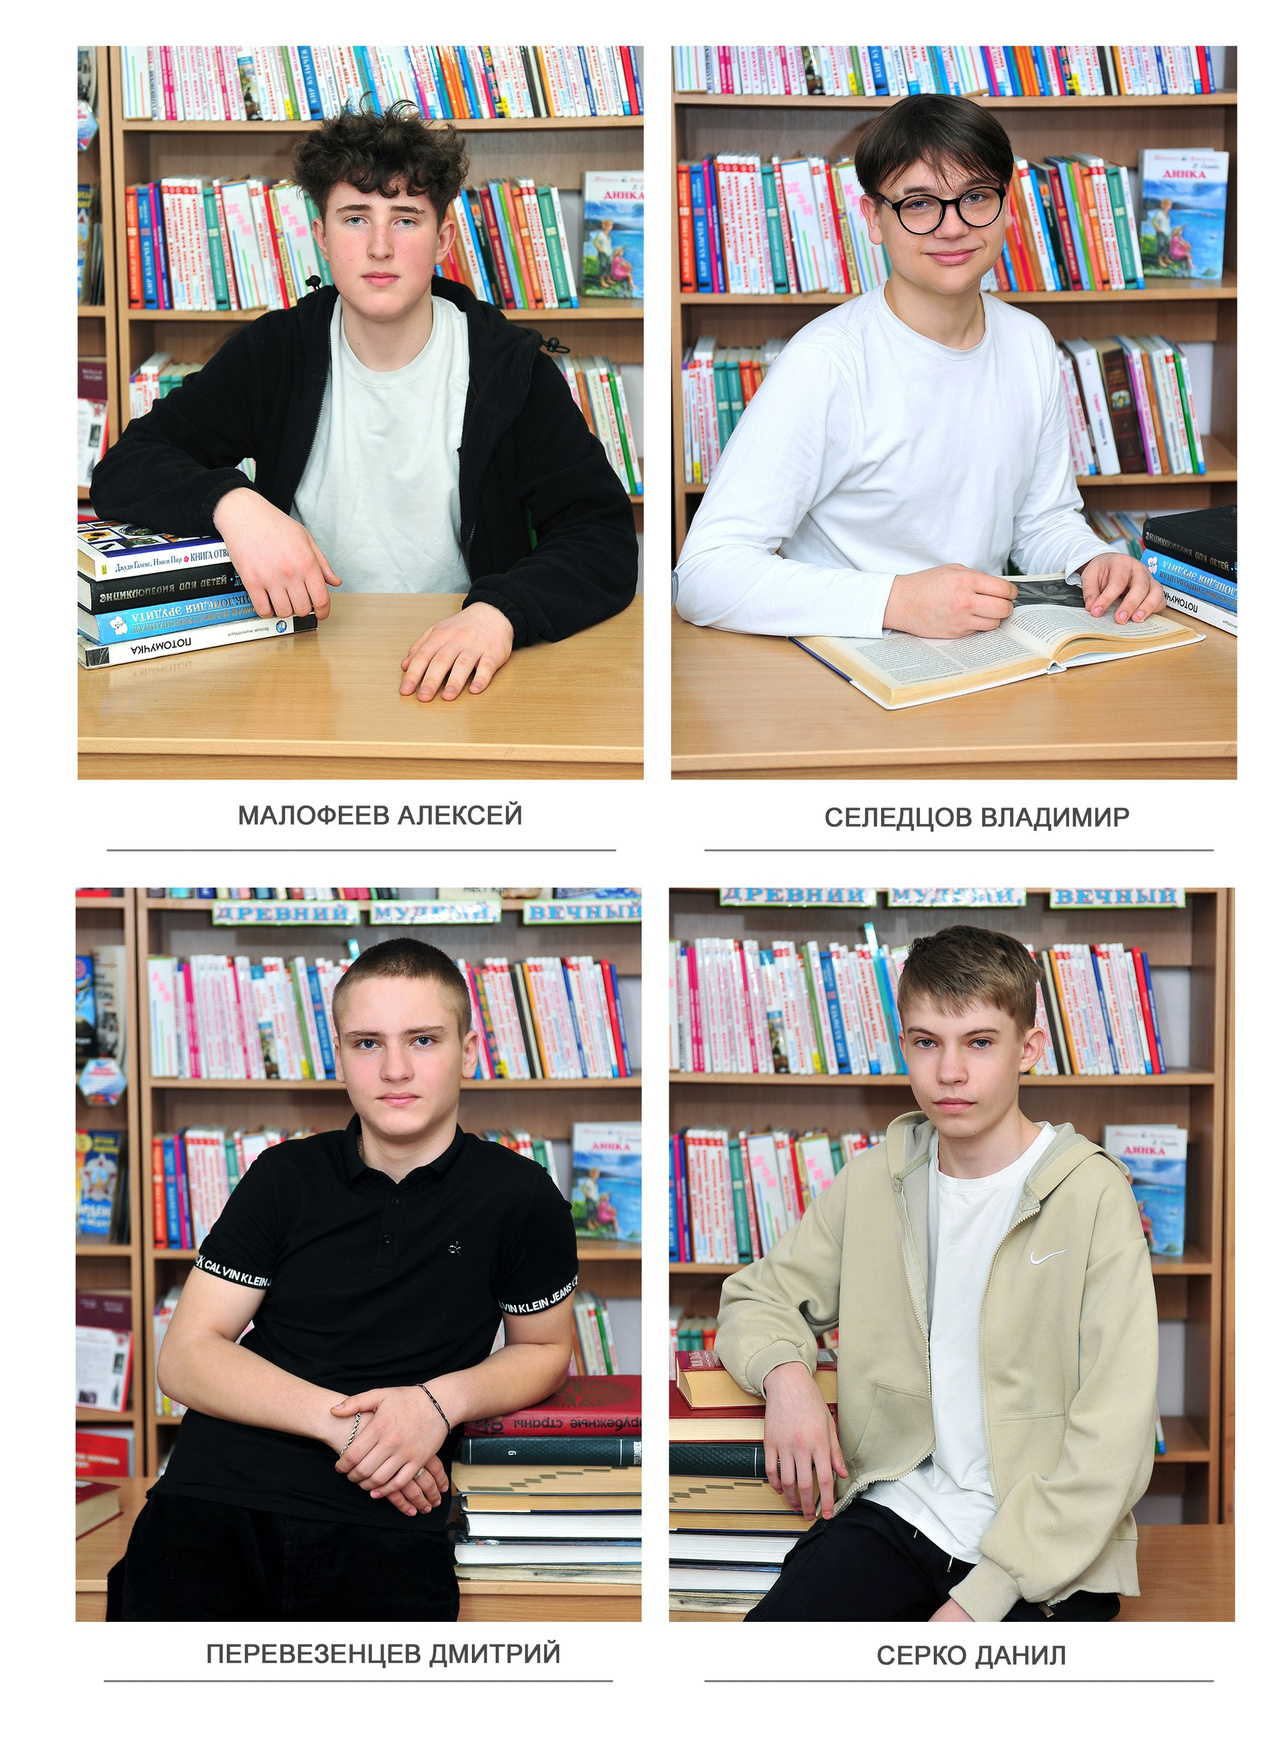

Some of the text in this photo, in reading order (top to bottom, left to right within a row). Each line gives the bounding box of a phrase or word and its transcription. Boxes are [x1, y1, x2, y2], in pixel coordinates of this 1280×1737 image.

[1164, 169, 1206, 180] ДИНКА
[190, 551, 213, 562] КНИГА
[200, 574, 227, 588] ДЕТЕЙ
[131, 593, 252, 621] ИКЛОПЕДИЯ ЭРУДИТА
[131, 637, 192, 654] ПОТОМУЧКА
[1056, 888, 1178, 905] ВЕЧНЫЙ
[216, 903, 357, 922] ДРЕВНИЙ,
[592, 1142, 630, 1151] ДИНКА
[1125, 1145, 1166, 1155] ДИНКА
[205, 1260, 268, 1286] CALVIN KLEIN
[518, 1282, 572, 1313] KLEIN JEANS
[514, 1417, 563, 1429] страны
